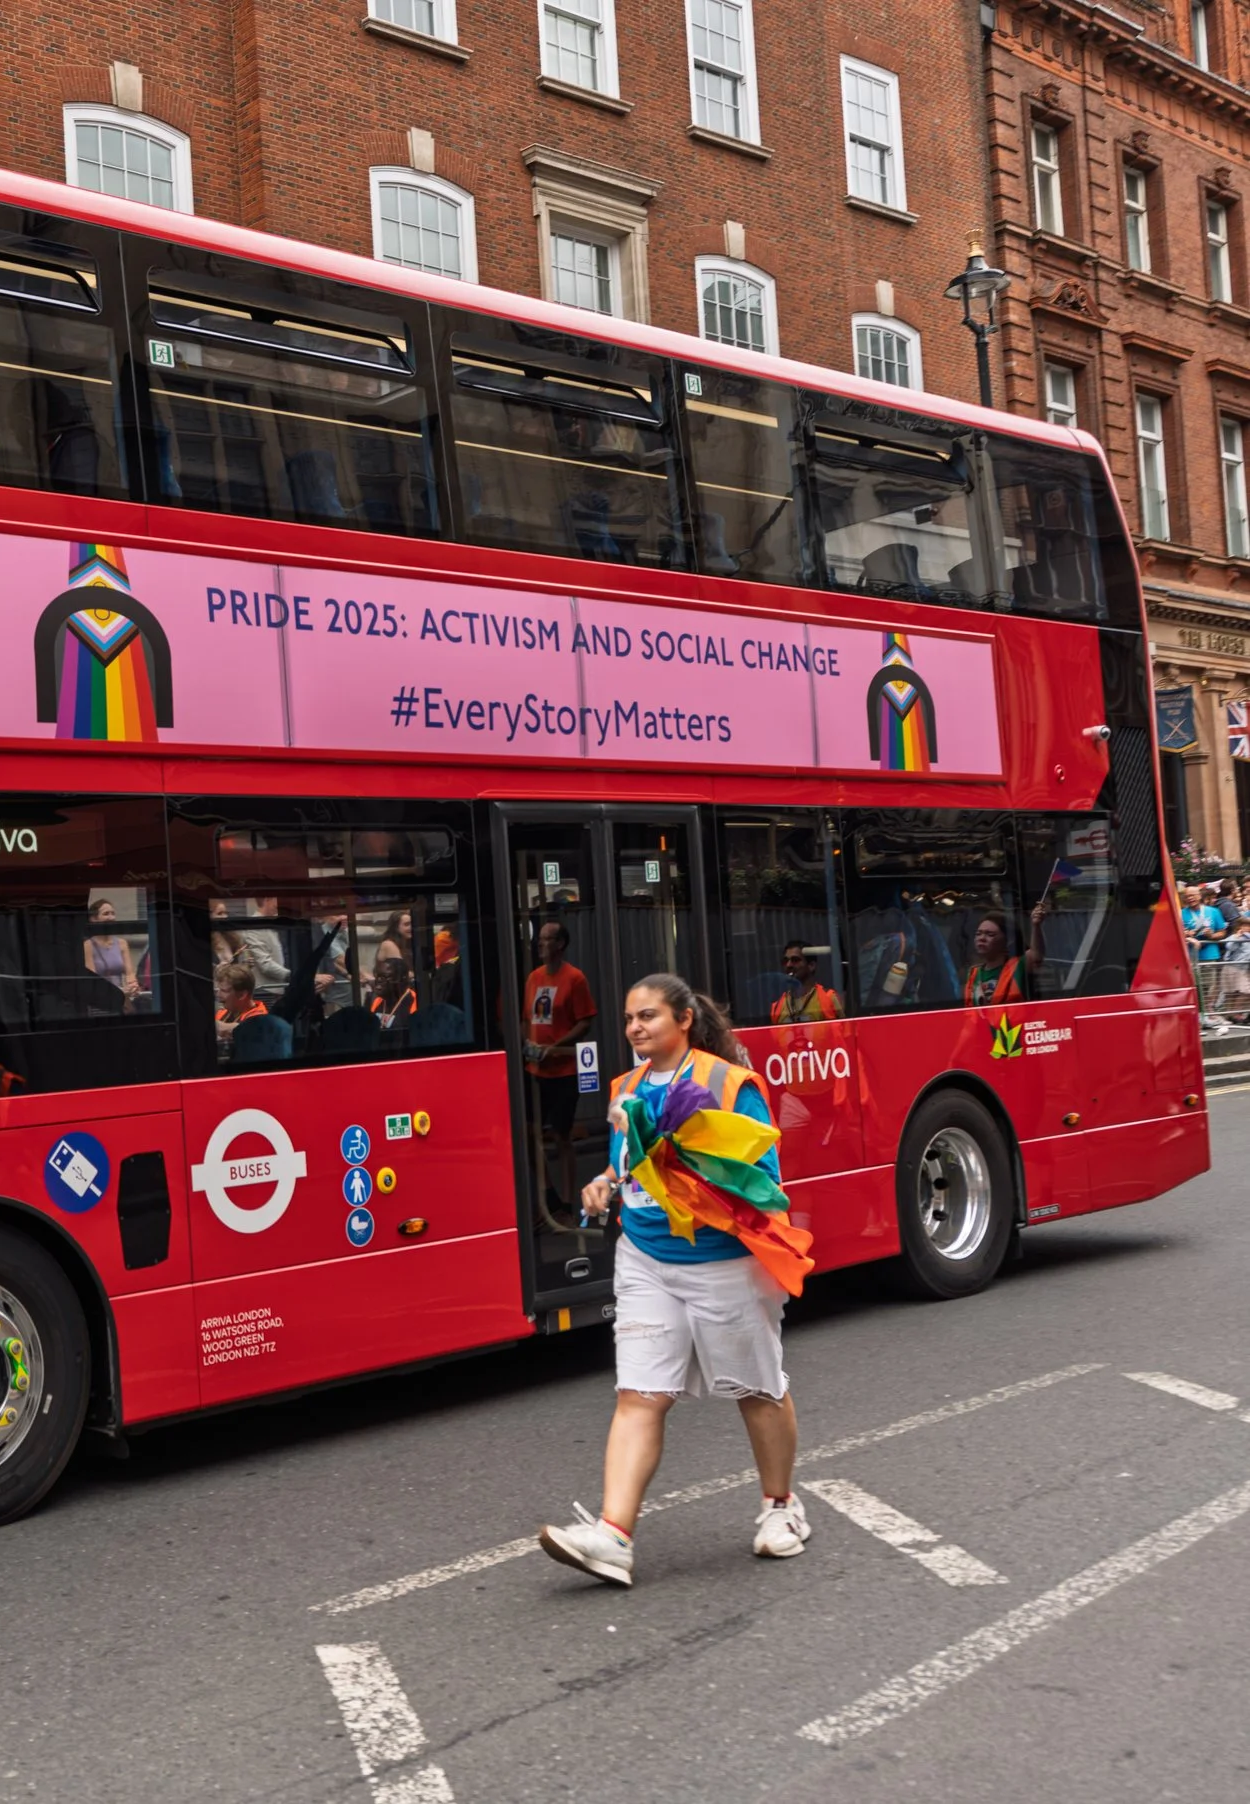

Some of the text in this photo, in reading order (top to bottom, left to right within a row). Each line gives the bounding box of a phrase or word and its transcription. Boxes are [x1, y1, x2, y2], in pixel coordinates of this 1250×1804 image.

[206, 587, 841, 677] PRIDE 2025: ACTIVISM AND SOCIAL CHANGE
[390, 686, 732, 746] #EveryStoryMatters
[765, 1041, 851, 1086] arriva
[230, 1162, 271, 1180] BUSES
[200, 1307, 272, 1330] ARRIVA LONDON
[201, 1316, 284, 1342] 16 WATSONS ROAD,
[202, 1332, 265, 1354] WOOD GREEN
[203, 1341, 276, 1366] LONDON N22 7TZ
